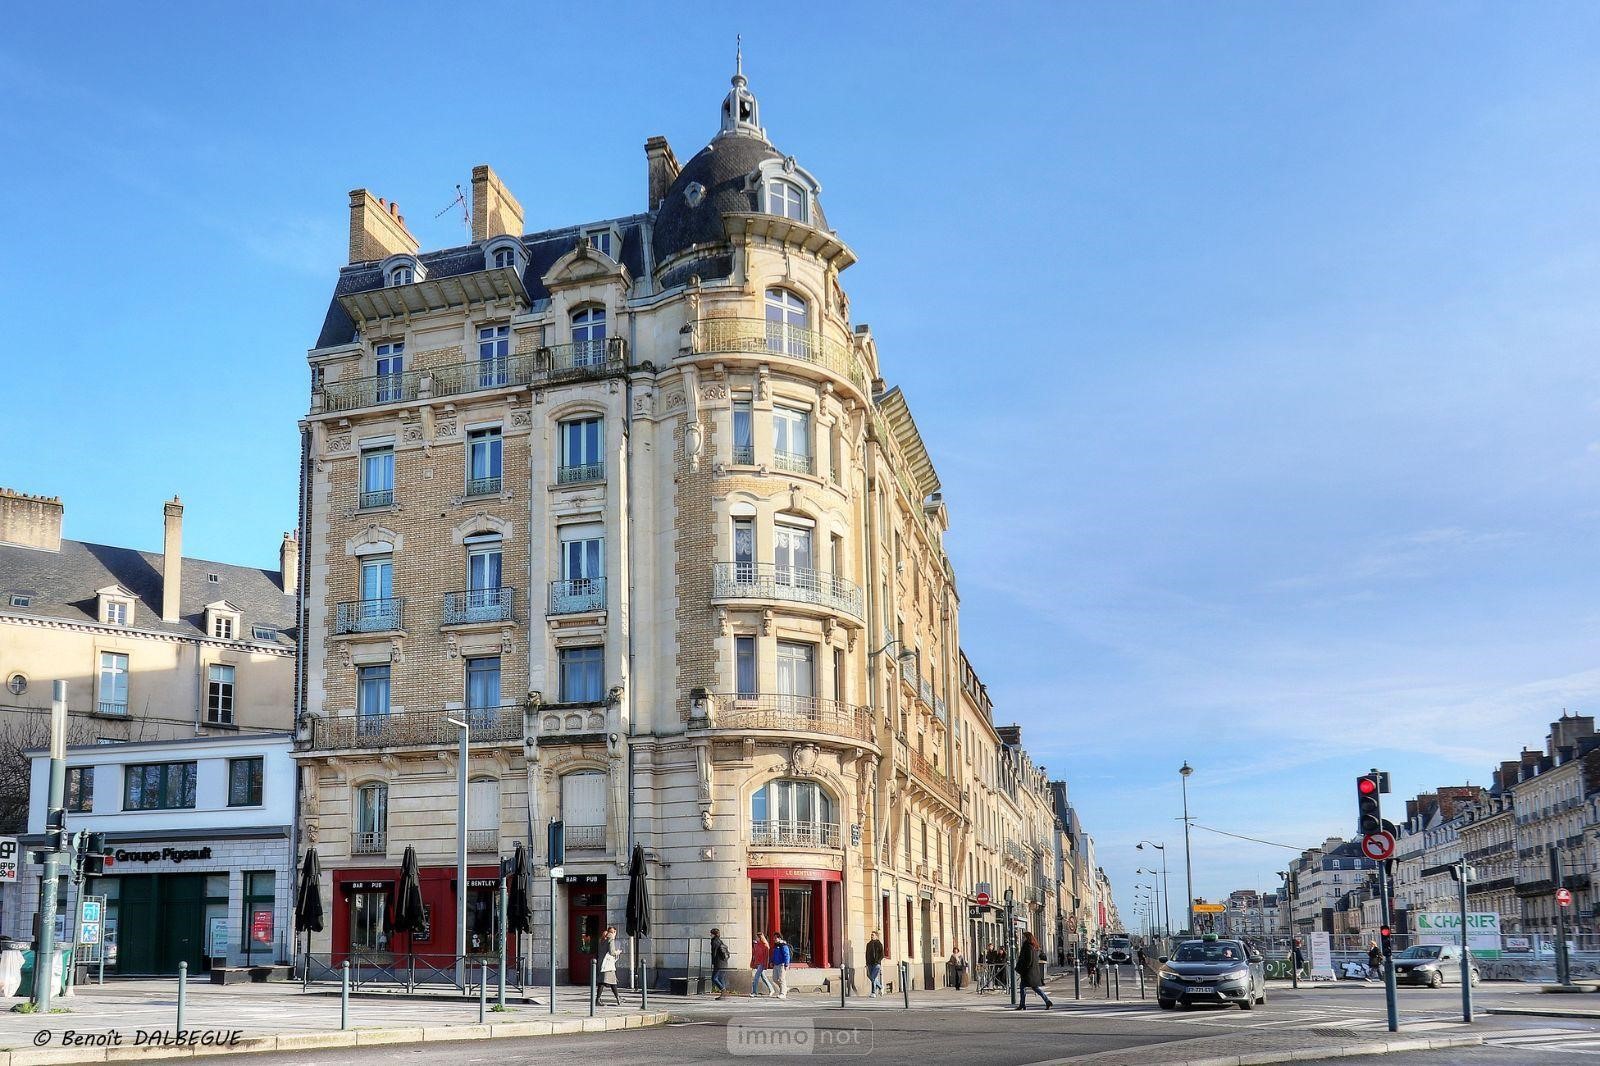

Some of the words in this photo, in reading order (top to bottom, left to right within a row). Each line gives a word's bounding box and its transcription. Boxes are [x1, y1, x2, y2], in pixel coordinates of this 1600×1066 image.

[116, 849, 160, 864] Groupe
[162, 847, 212, 863] Pigeault
[1433, 914, 1496, 929] CHARIER
